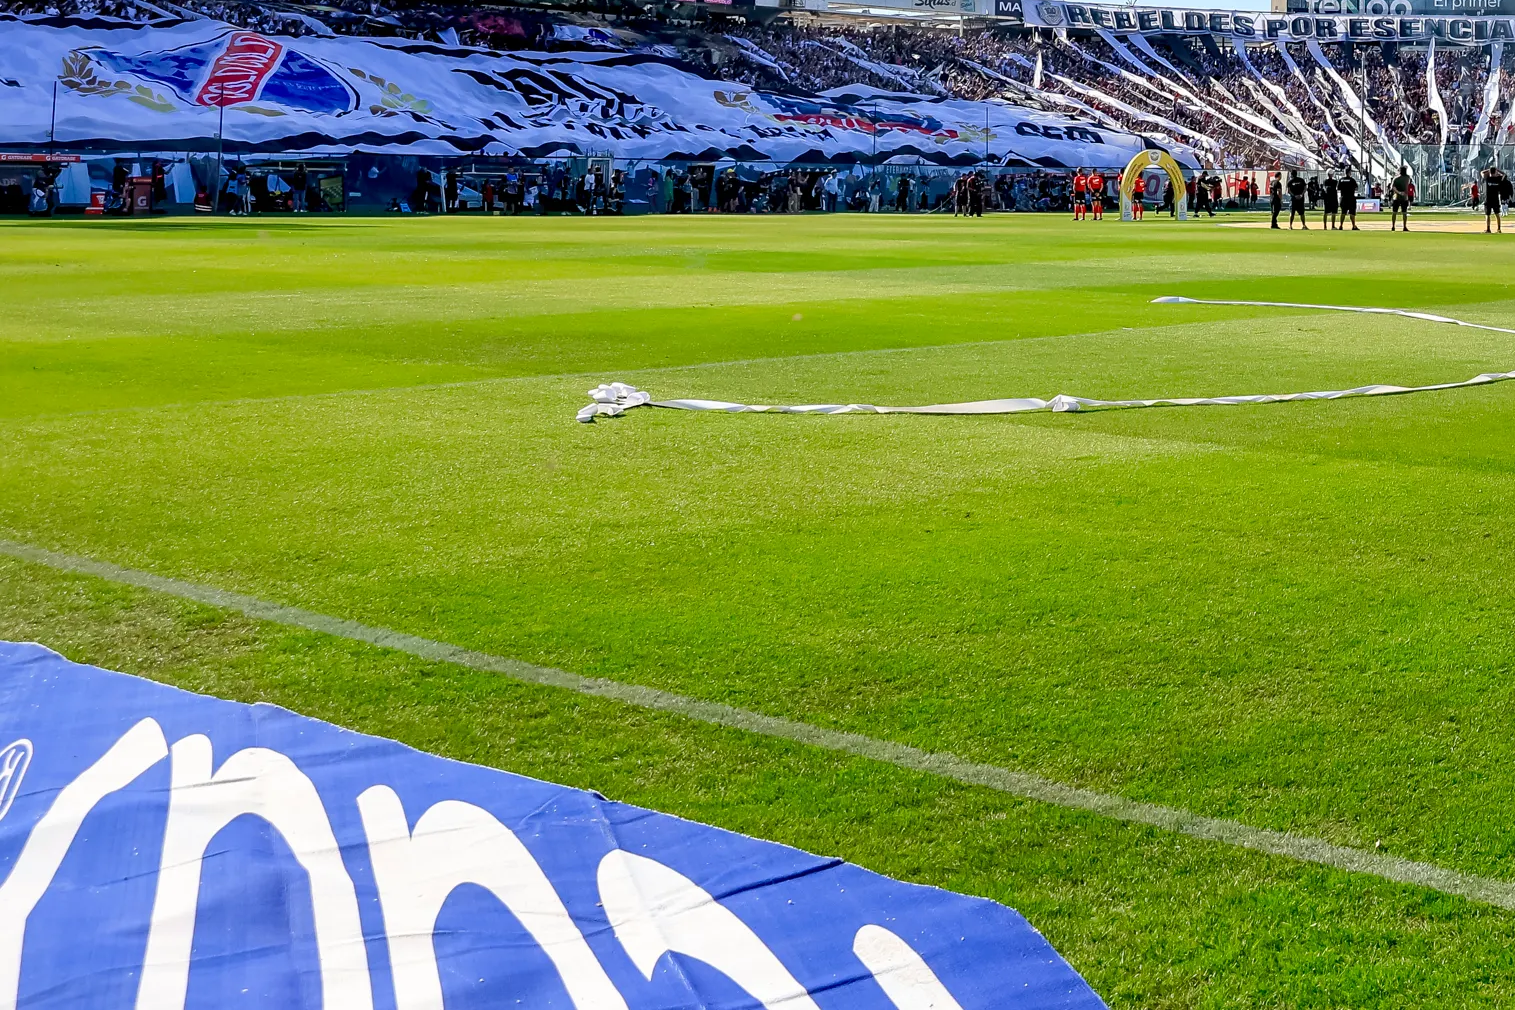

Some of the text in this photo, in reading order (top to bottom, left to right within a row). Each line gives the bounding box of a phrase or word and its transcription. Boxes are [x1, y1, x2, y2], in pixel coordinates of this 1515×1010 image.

[1267, 17, 1338, 39] POR
[1350, 18, 1514, 40] ESENCIA
[137, 196, 147, 207] G
